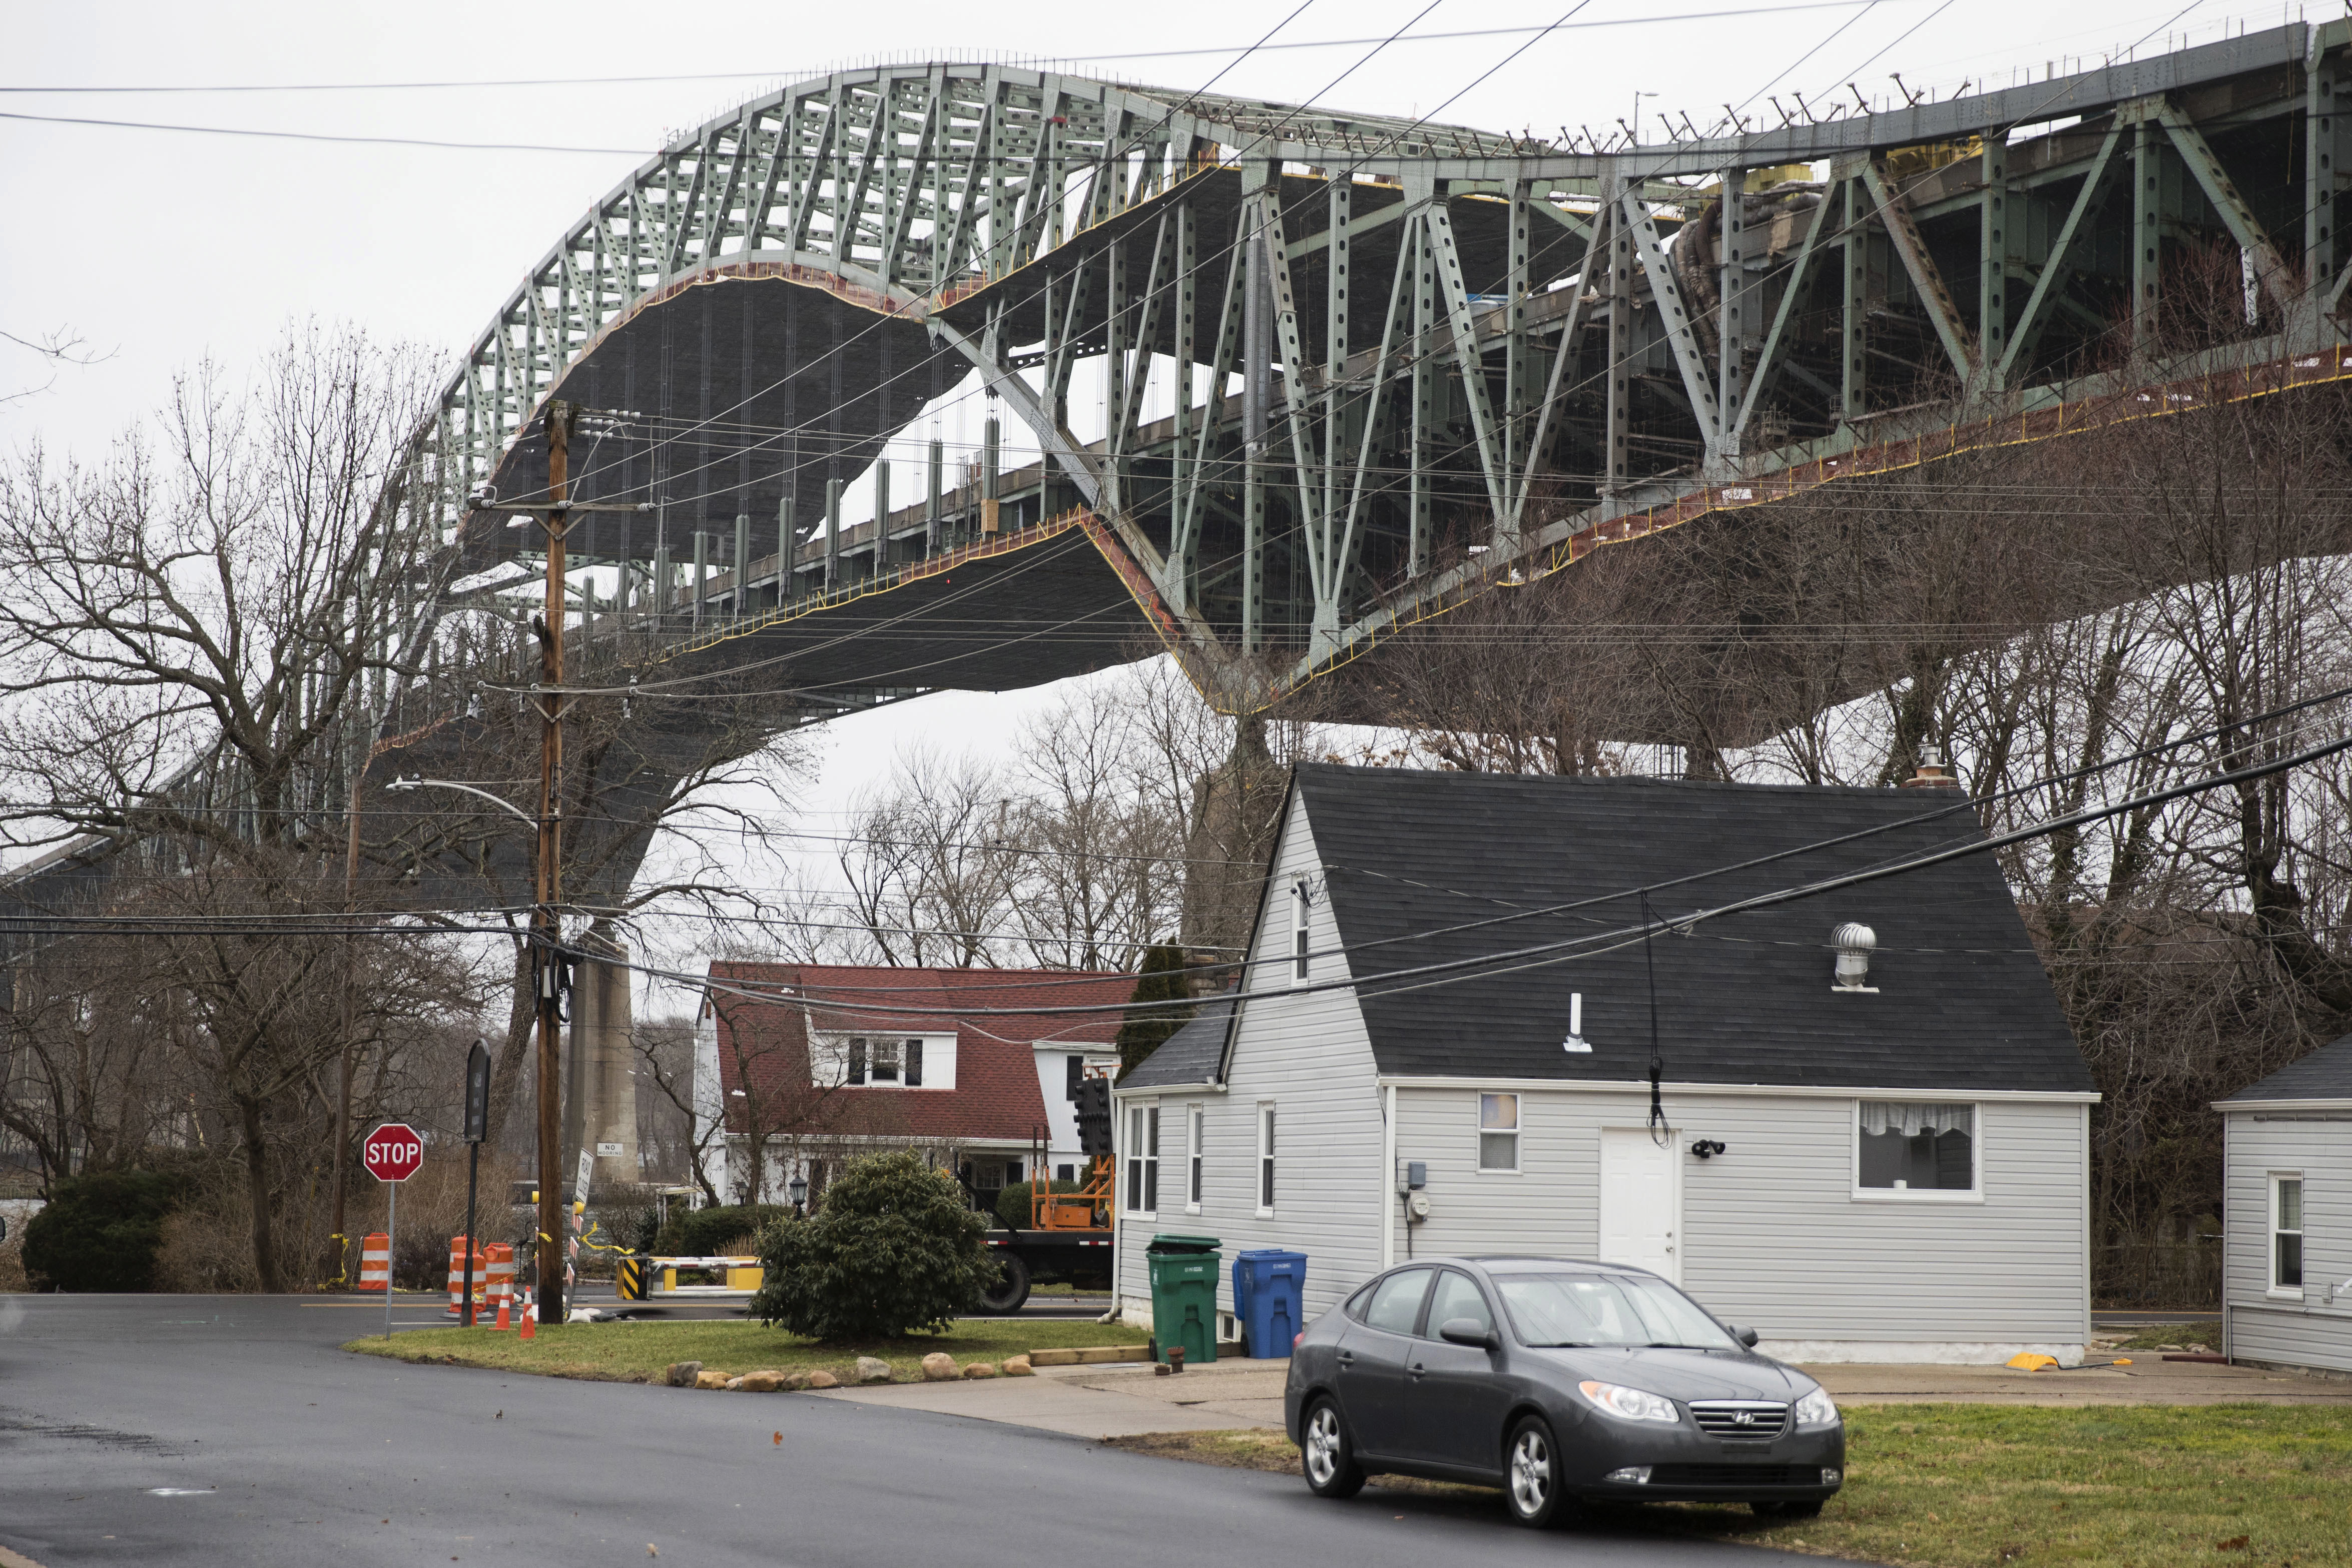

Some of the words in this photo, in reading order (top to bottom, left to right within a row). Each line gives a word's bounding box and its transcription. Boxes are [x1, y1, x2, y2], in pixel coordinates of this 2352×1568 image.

[368, 1143, 418, 1164] STOP
[581, 1157, 590, 1175] ROAD
[577, 1176, 588, 1197] CLOSED
